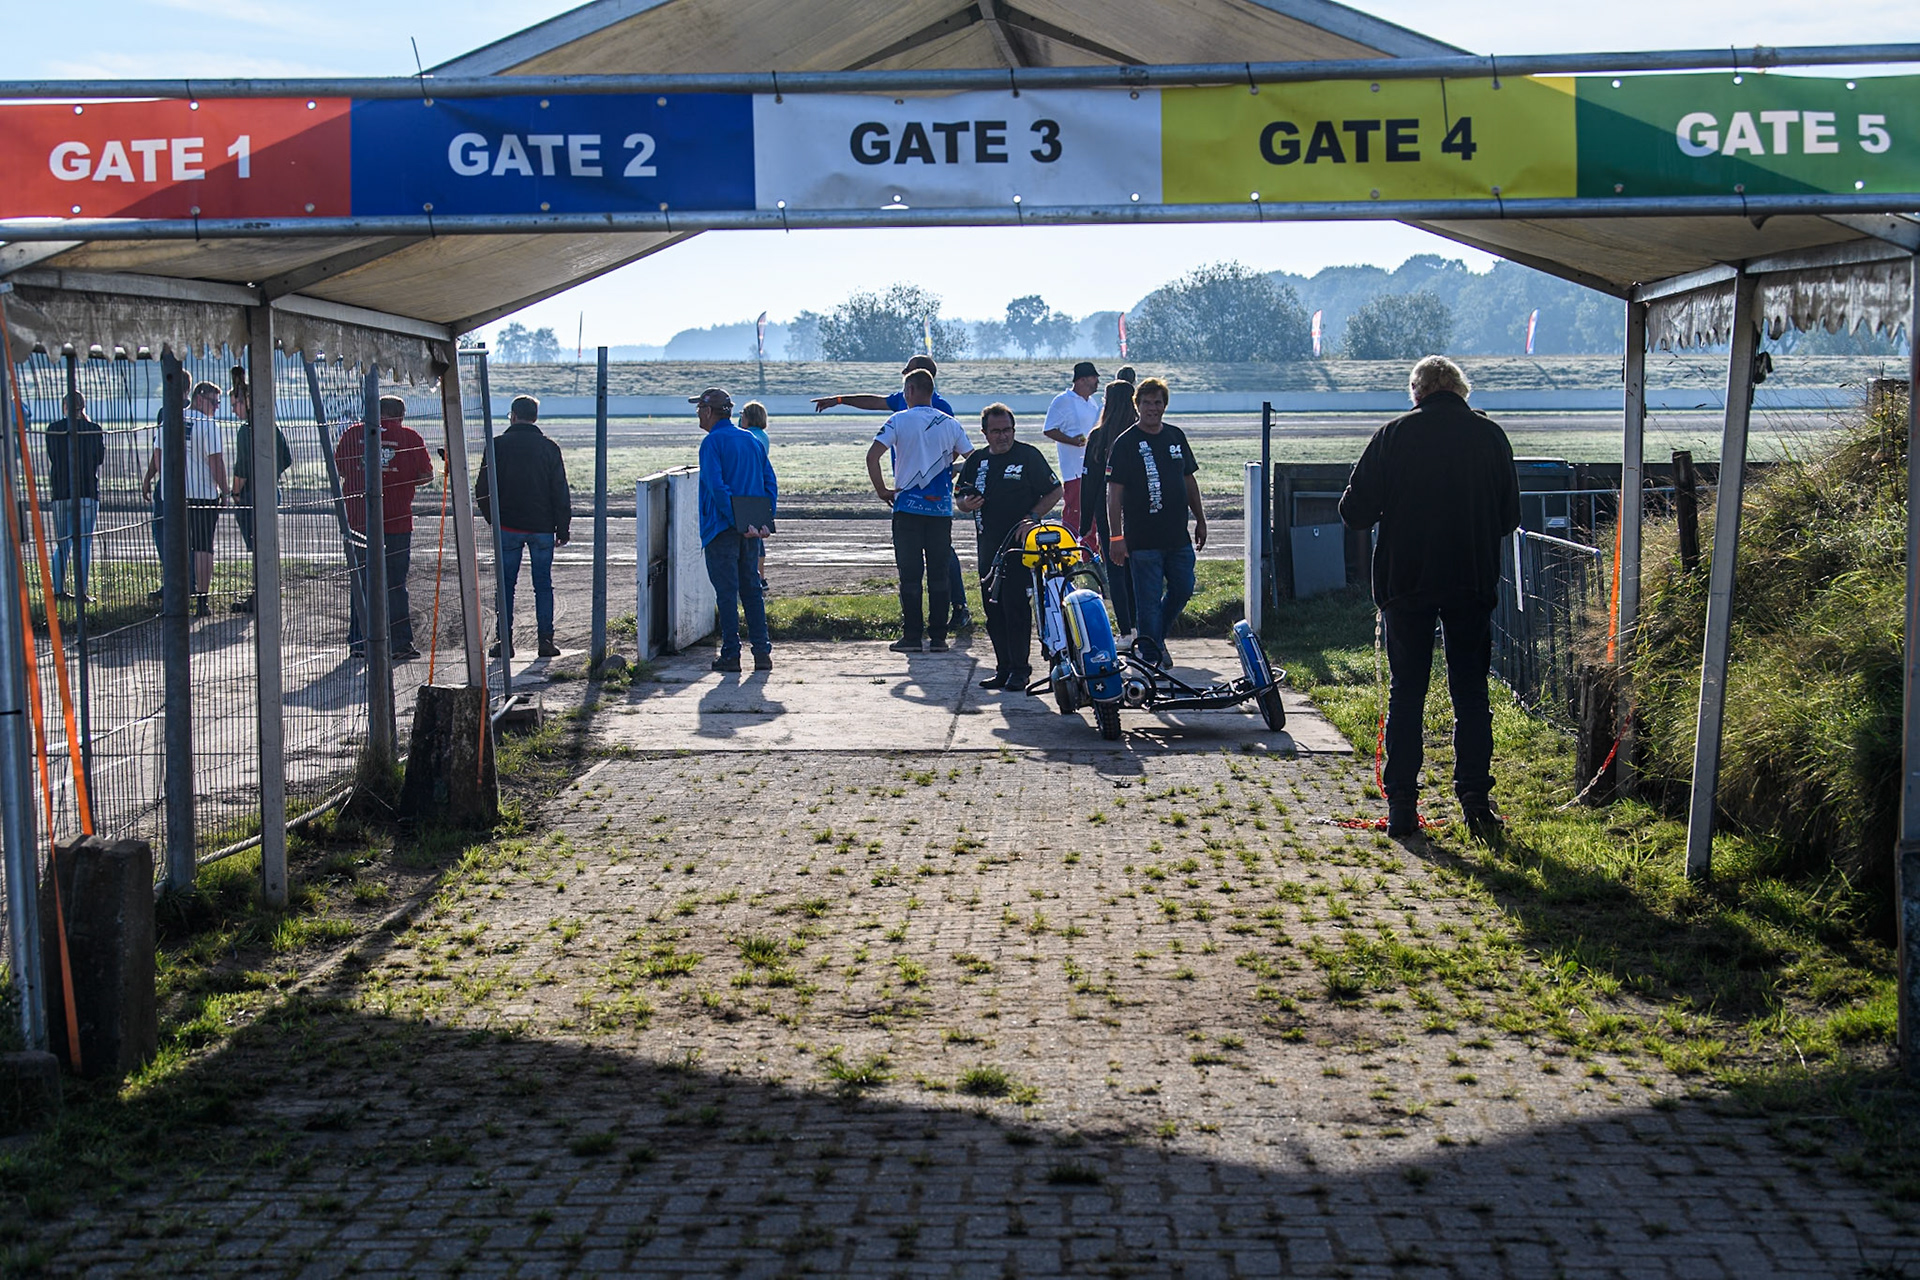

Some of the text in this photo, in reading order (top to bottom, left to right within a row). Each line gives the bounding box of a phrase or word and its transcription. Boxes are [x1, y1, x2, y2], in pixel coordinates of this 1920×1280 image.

[447, 133, 658, 177] GATE 2
[850, 119, 1063, 165] GATE 3
[1258, 116, 1478, 165] GATE 4
[1676, 111, 1891, 156] GATE 5
[49, 135, 251, 183] GATE 1
[1004, 464, 1024, 474] 84
[1169, 444, 1182, 454] 84
